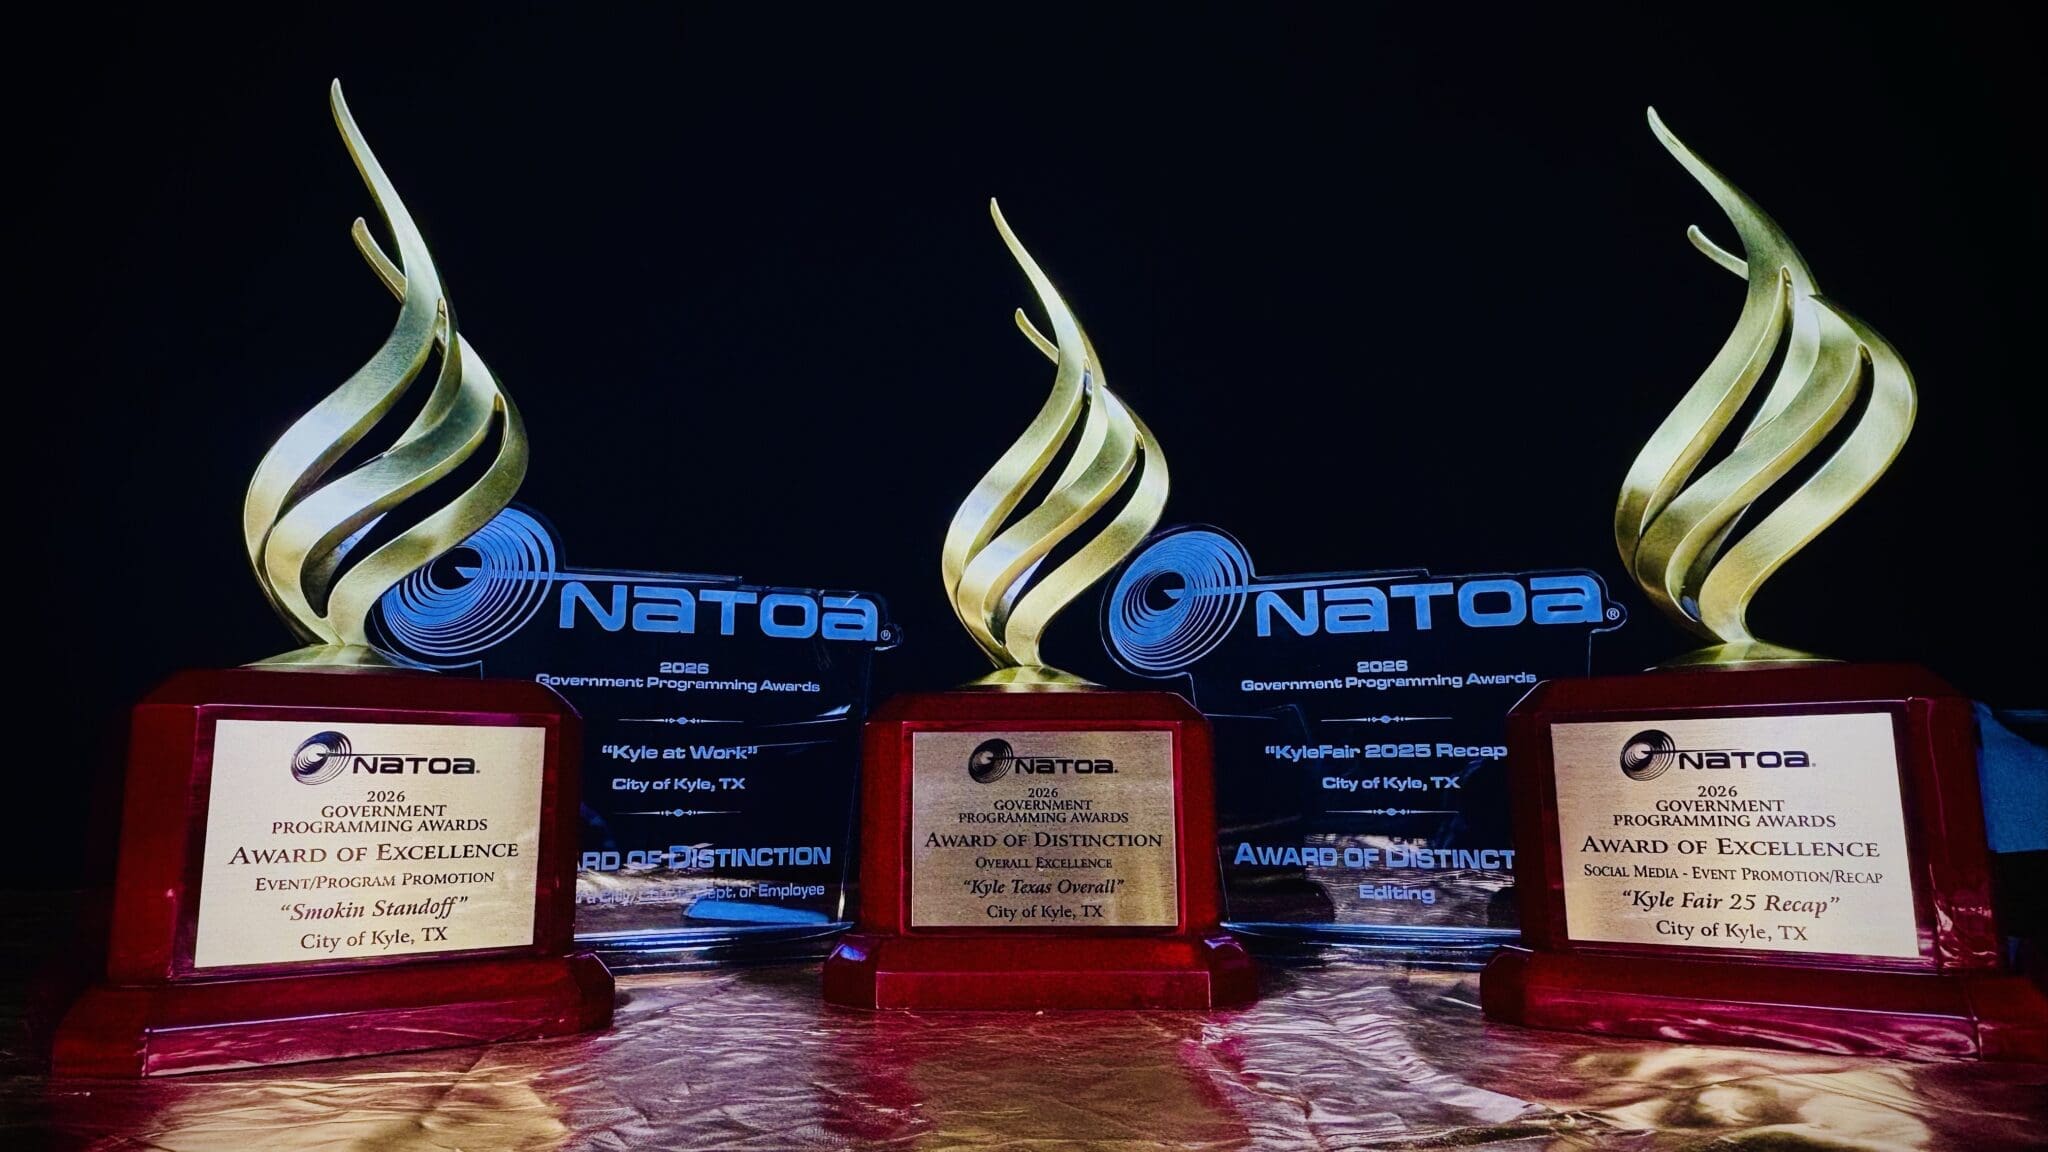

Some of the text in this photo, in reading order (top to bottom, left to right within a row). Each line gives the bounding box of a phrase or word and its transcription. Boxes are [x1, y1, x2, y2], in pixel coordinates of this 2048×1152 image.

[660, 662, 709, 674] 2026
[1356, 660, 1408, 673] 2026
[536, 673, 820, 693] Government Programming Awards
[1241, 672, 1536, 692] Government Programming Awards
[602, 745, 758, 762] “Kyle at Work”
[1265, 744, 1508, 761] “KyleFair 2025 Recap
[612, 778, 745, 792] City of Kyle, TX
[1322, 776, 1461, 791] City of Kyle, TX
[1698, 786, 1738, 797] 2026
[367, 791, 405, 802] 2026
[1028, 788, 1058, 798] 2026
[321, 805, 447, 818] GOVERNMENT
[994, 800, 1093, 810] GOVERNMENT
[1656, 800, 1785, 812] GOVERNMENT
[959, 812, 1129, 823] PROGRAMMING AWARDS
[1613, 815, 1836, 828] PROGRAMMING AWARDS
[272, 819, 488, 834] PROGRAMMING AWARDS
[924, 832, 1163, 847] AWARD OF DISTINCTION
[1581, 836, 1880, 858] AWARD OF EXCELLENCE
[228, 843, 519, 865] AWARD OF EXCELLENCE
[627, 850, 662, 870] OF
[669, 846, 831, 869] DISTINCTION
[1234, 842, 1337, 866] AWARD
[1344, 849, 1380, 867] OF
[975, 857, 1113, 869] OVERALL EXCELLENCE
[1584, 864, 1629, 877] SOCIAL
[1634, 866, 1678, 879] MEDIA
[1693, 866, 1736, 880] EVENT
[255, 872, 494, 891] EVENT/PROGRAM PROMOTION
[963, 879, 1124, 898] “Kyle Texas Overall”
[739, 886, 753, 898] or
[758, 882, 825, 900] Employee
[1359, 884, 1435, 904] Editing
[281, 896, 468, 921] “Smokin Standoff”
[1623, 889, 1839, 918] “Kyle Fair 25 Recap”
[987, 905, 1103, 922] City of Kyle, TX
[301, 927, 448, 952] City of Kyle, TX
[1656, 920, 1808, 943] City of Kyle, TX
